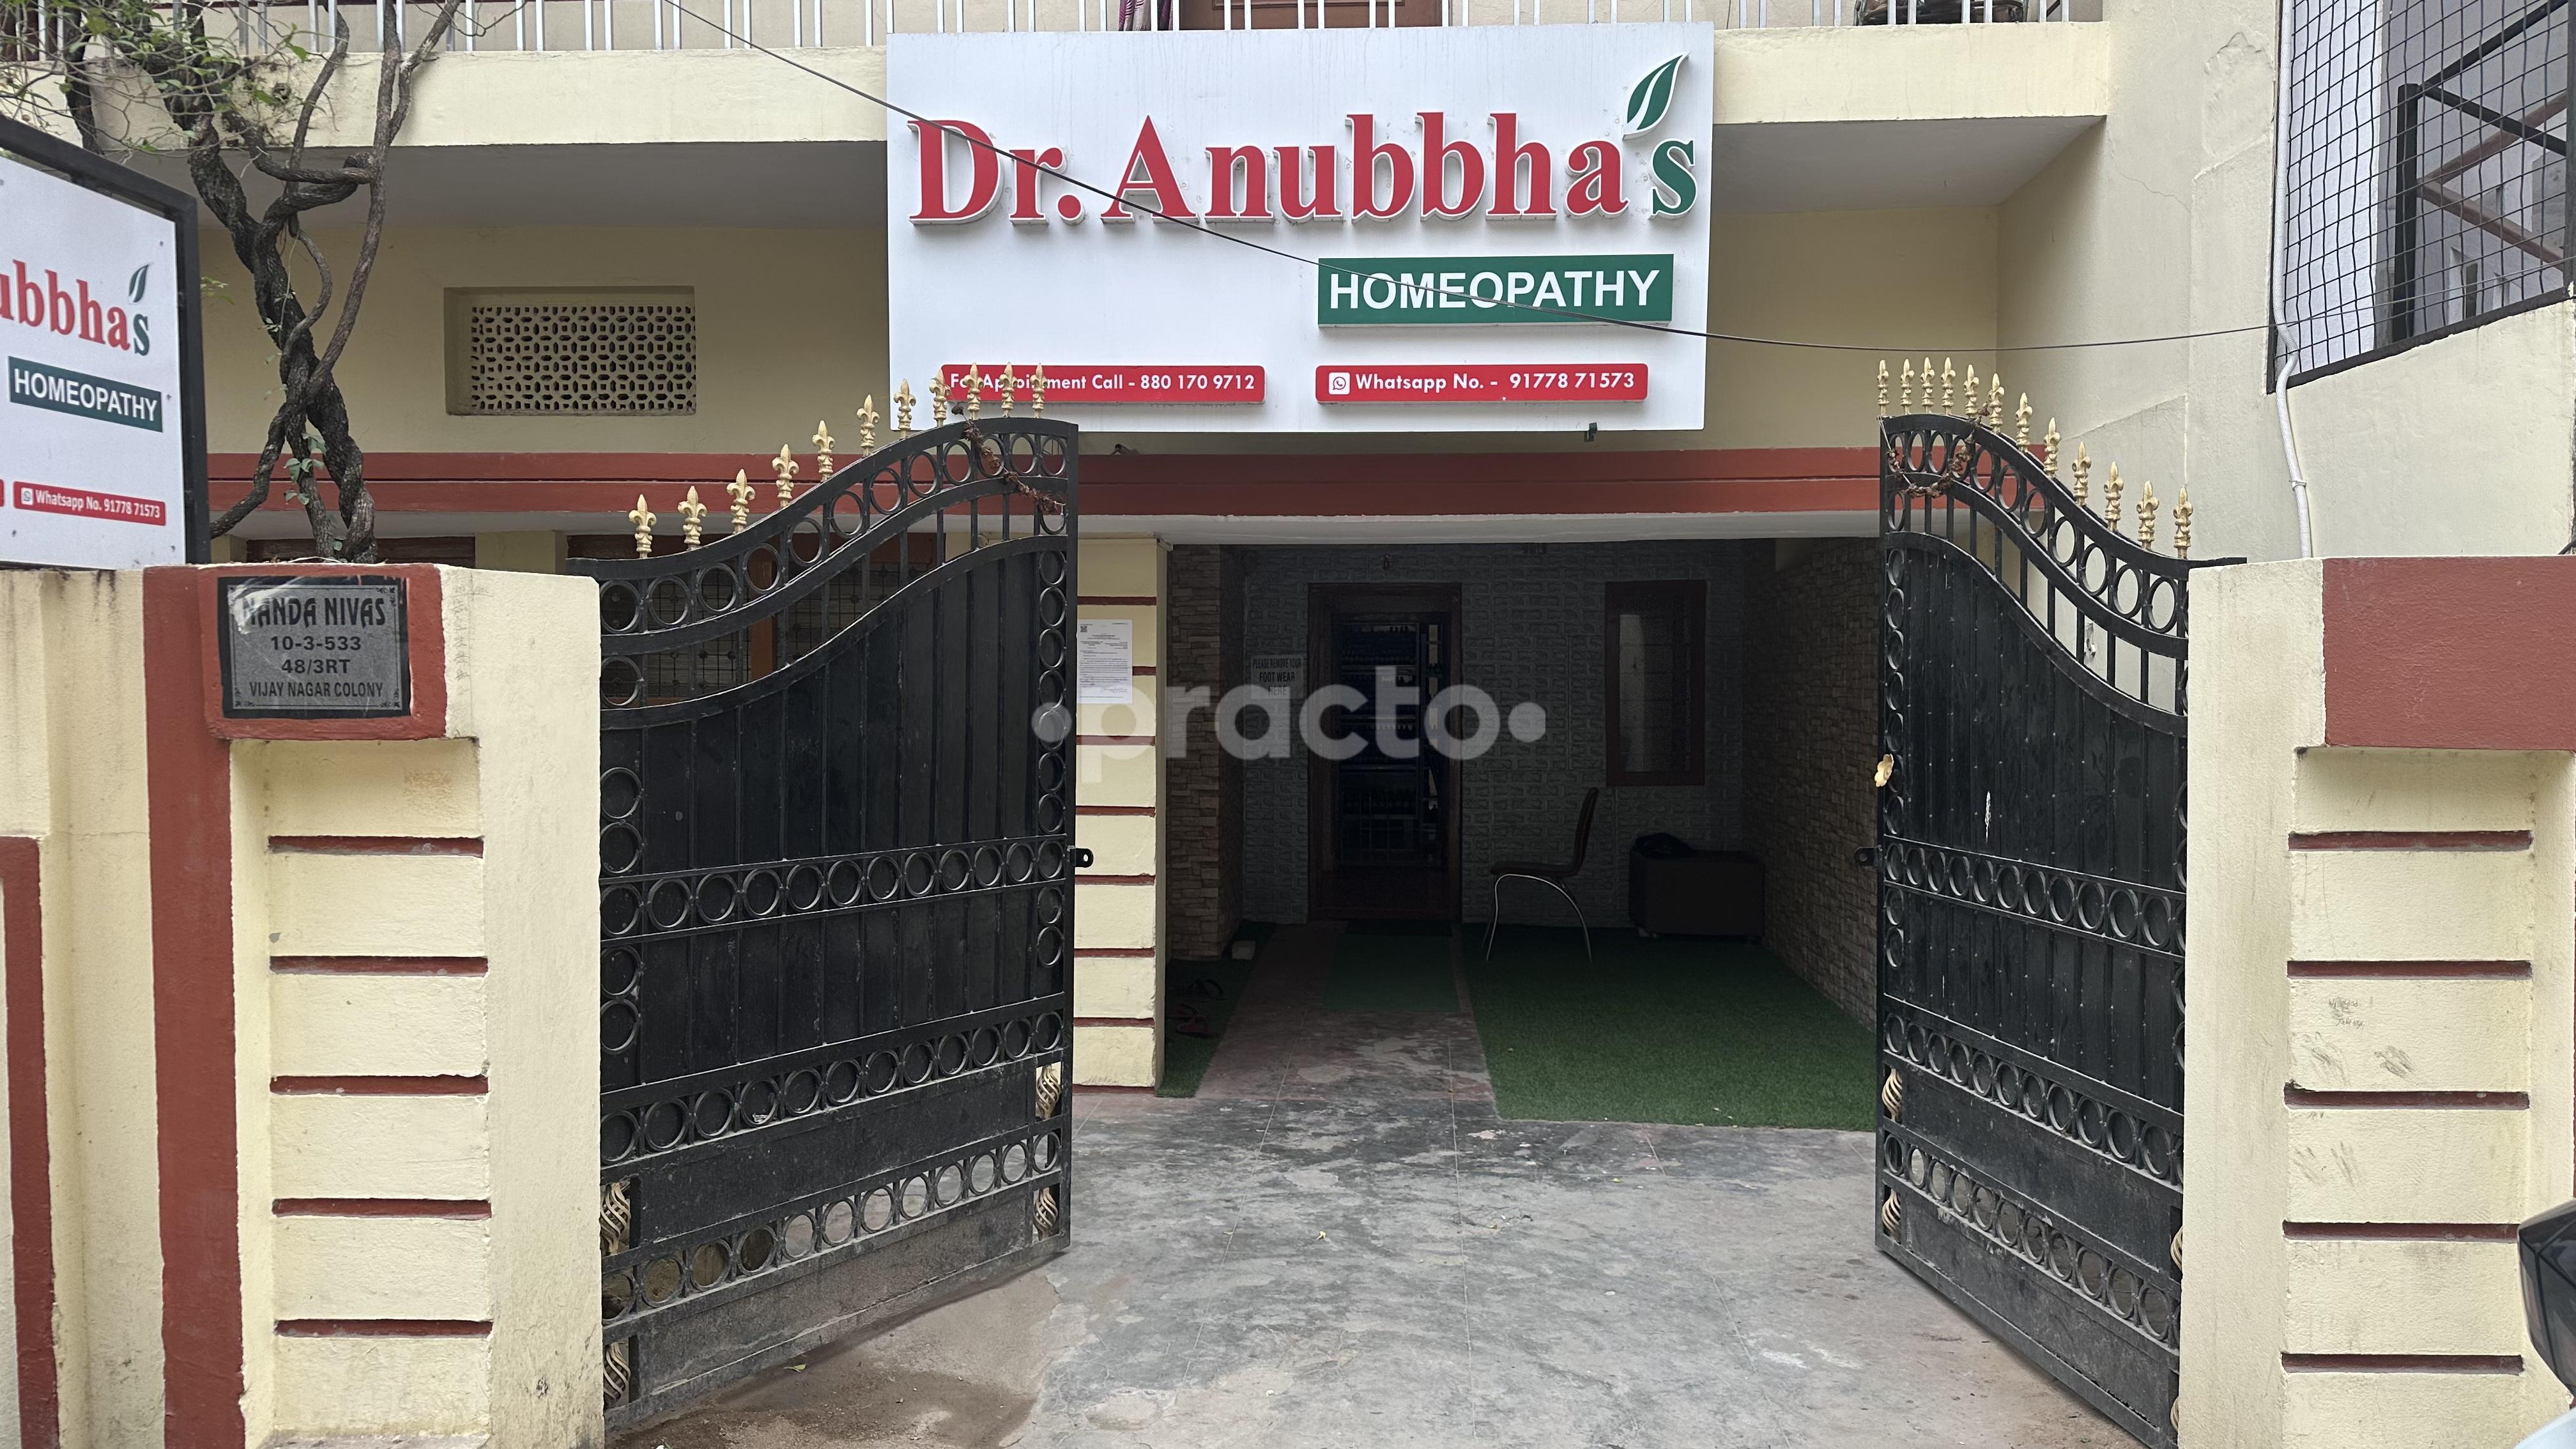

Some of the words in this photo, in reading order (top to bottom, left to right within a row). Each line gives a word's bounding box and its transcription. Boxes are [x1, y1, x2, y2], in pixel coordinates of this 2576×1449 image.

[1329, 268, 1661, 310] HOMEOPATHY
[1092, 374, 1123, 390] Call
[1140, 374, 1172, 390] 880
[1178, 374, 1208, 390] 170
[1213, 374, 1255, 391] 9712
[1355, 373, 1446, 394] Whatsapp
[1453, 373, 1484, 389] No.
[1509, 372, 1568, 389] 91778
[1574, 372, 1636, 389] 71573
[14, 368, 157, 422] HOMEOPATHY
[35, 489, 84, 511] Whatsapp
[86, 496, 102, 511] No.
[104, 498, 132, 515] 91778
[134, 503, 160, 519] 71573
[325, 597, 385, 628] NIVAS
[271, 636, 362, 650] 10-3-533
[281, 659, 350, 674] 48/3RT
[1259, 672, 1275, 682] FOOT
[1276, 671, 1295, 682] WEAR
[249, 682, 284, 697] VIJAY
[288, 682, 330, 697] NAGAR
[334, 682, 383, 697] COLONY
